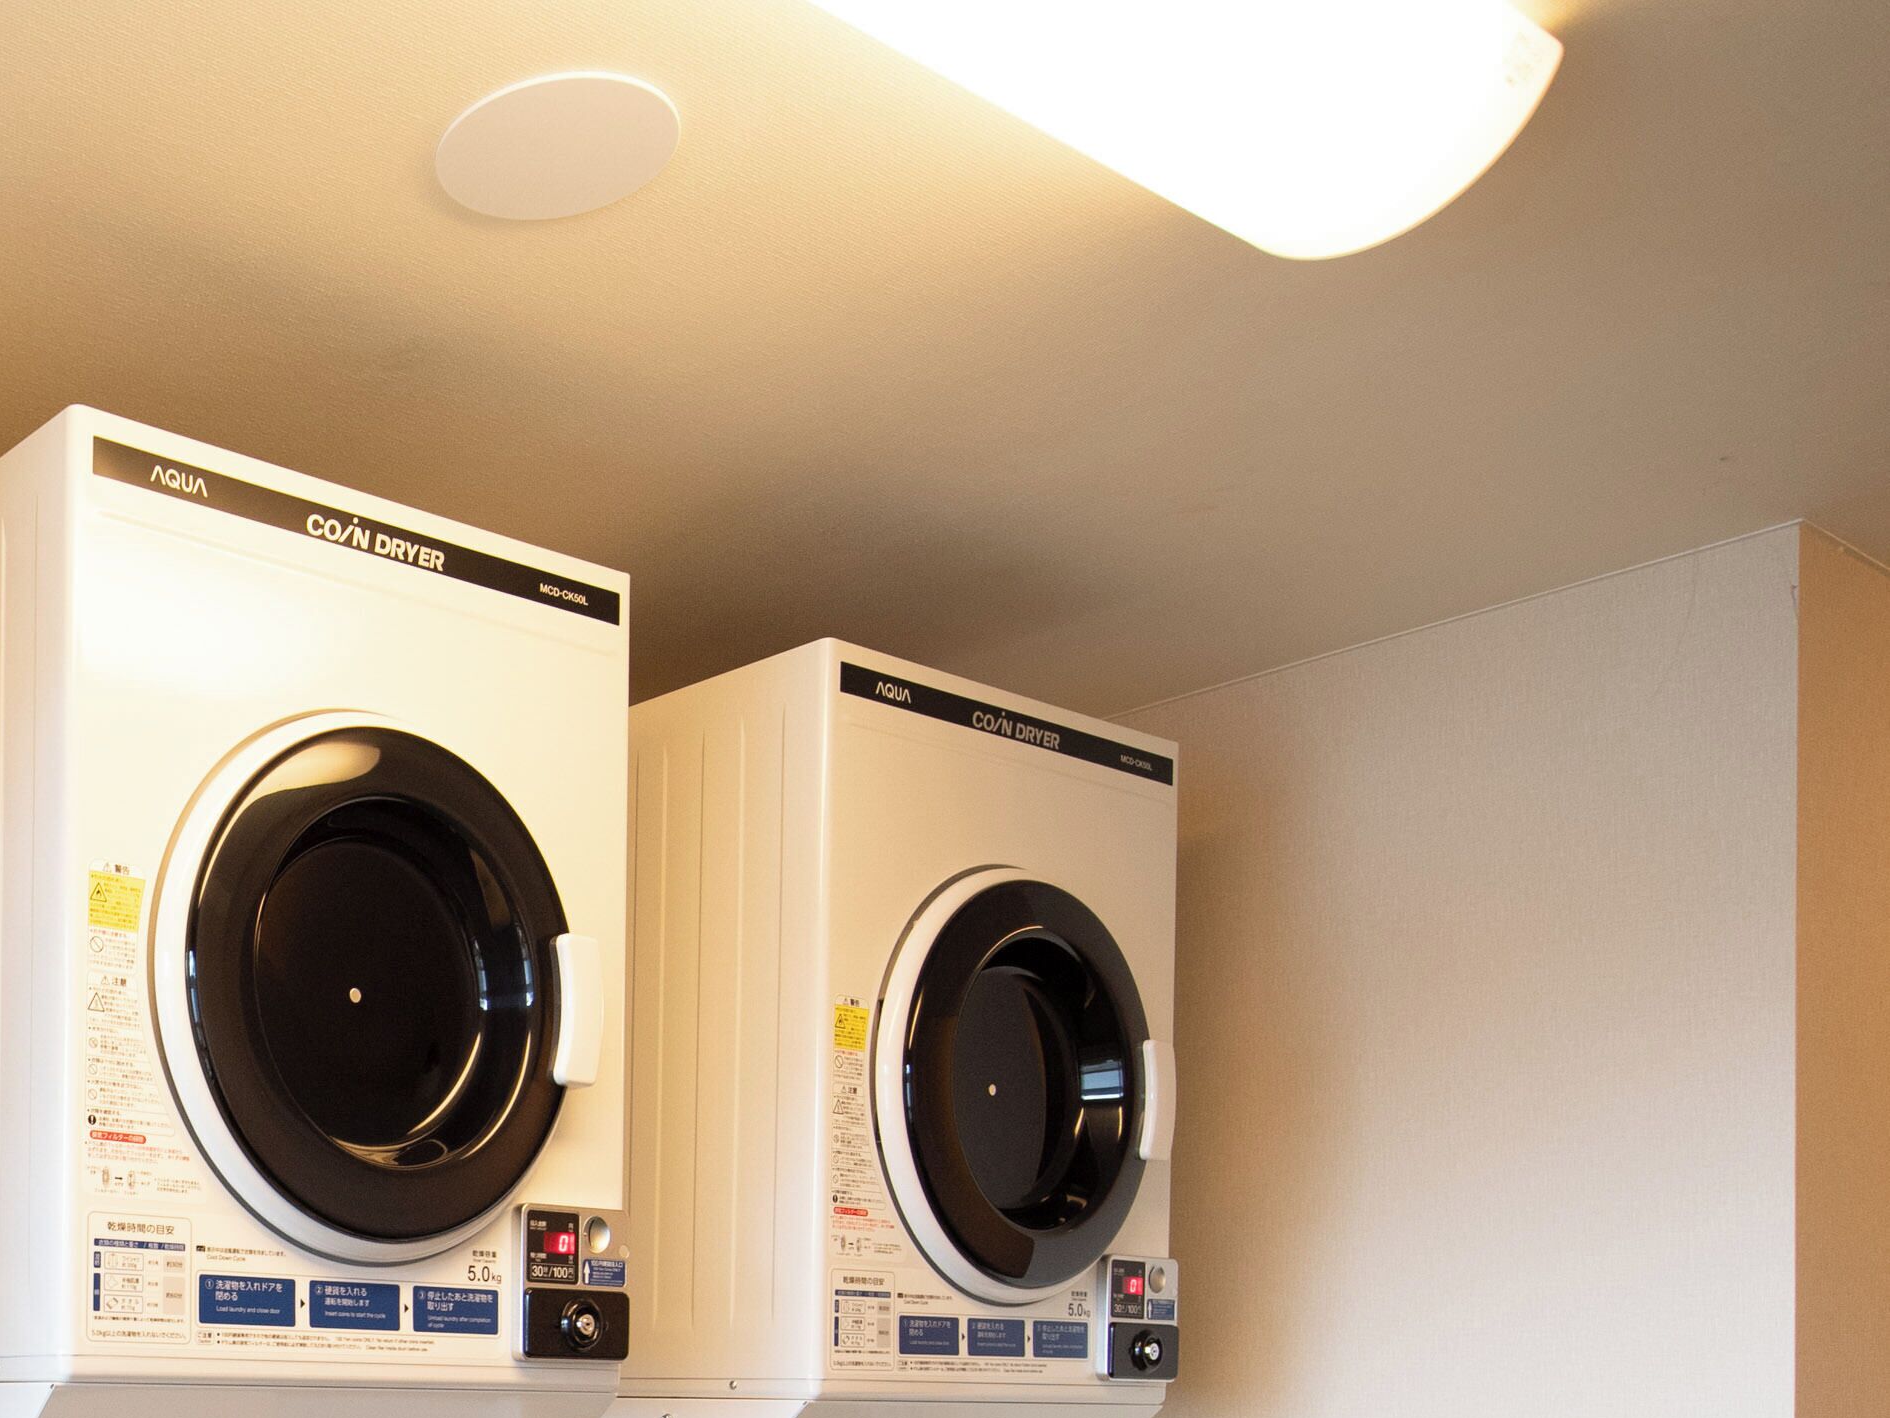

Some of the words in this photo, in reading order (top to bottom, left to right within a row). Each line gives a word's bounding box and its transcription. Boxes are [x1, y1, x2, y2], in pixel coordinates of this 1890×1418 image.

[150, 464, 208, 498] AQUA
[374, 535, 445, 572] DRYER
[539, 582, 588, 607] MCD-CK50L
[875, 681, 911, 704] AQUA
[1015, 722, 1060, 750] DRYER
[107, 1221, 175, 1236] 乾燥時間の目安
